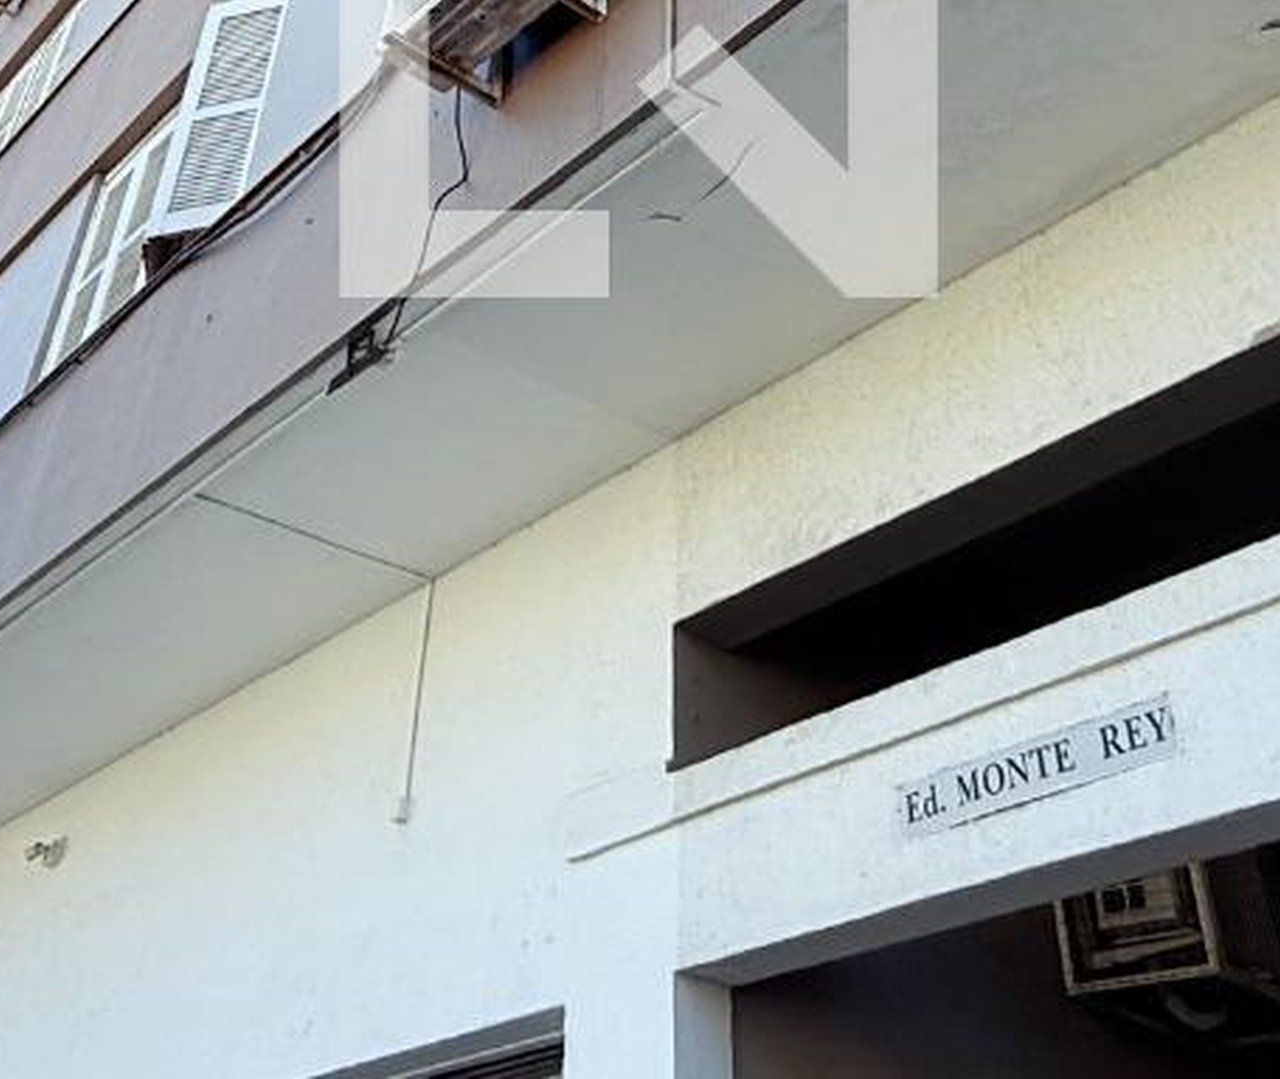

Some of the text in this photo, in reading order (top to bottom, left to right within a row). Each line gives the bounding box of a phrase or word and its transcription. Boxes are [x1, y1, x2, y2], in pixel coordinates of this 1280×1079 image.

[904, 706, 1169, 824] Ed. MONTE REY
